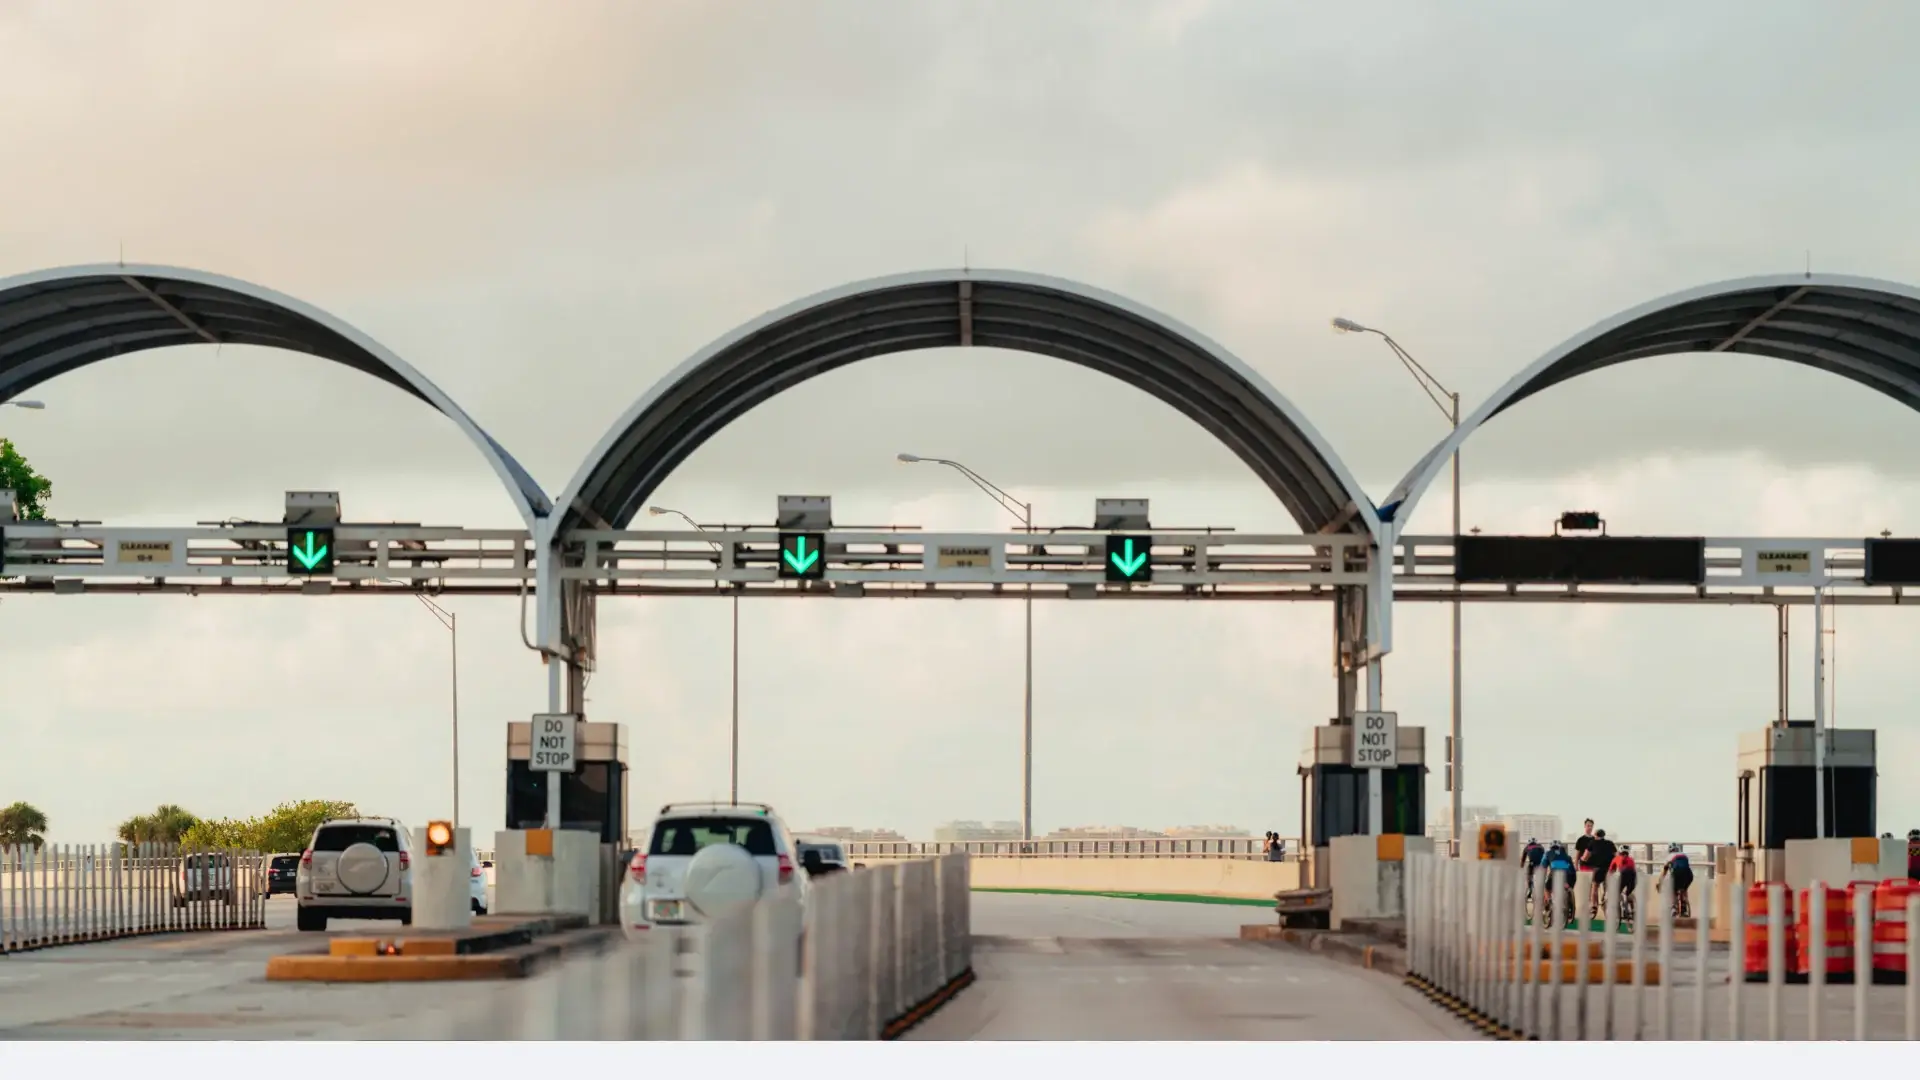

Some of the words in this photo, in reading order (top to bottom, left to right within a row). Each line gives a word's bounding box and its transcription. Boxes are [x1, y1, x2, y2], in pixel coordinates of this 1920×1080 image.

[1758, 552, 1808, 560] CLEARANCE
[545, 719, 563, 733] DO
[1366, 716, 1384, 730] DO
[540, 736, 567, 749] NOT
[1361, 732, 1388, 746] NOT
[536, 751, 570, 766] STOP
[1358, 749, 1392, 762] STOP
